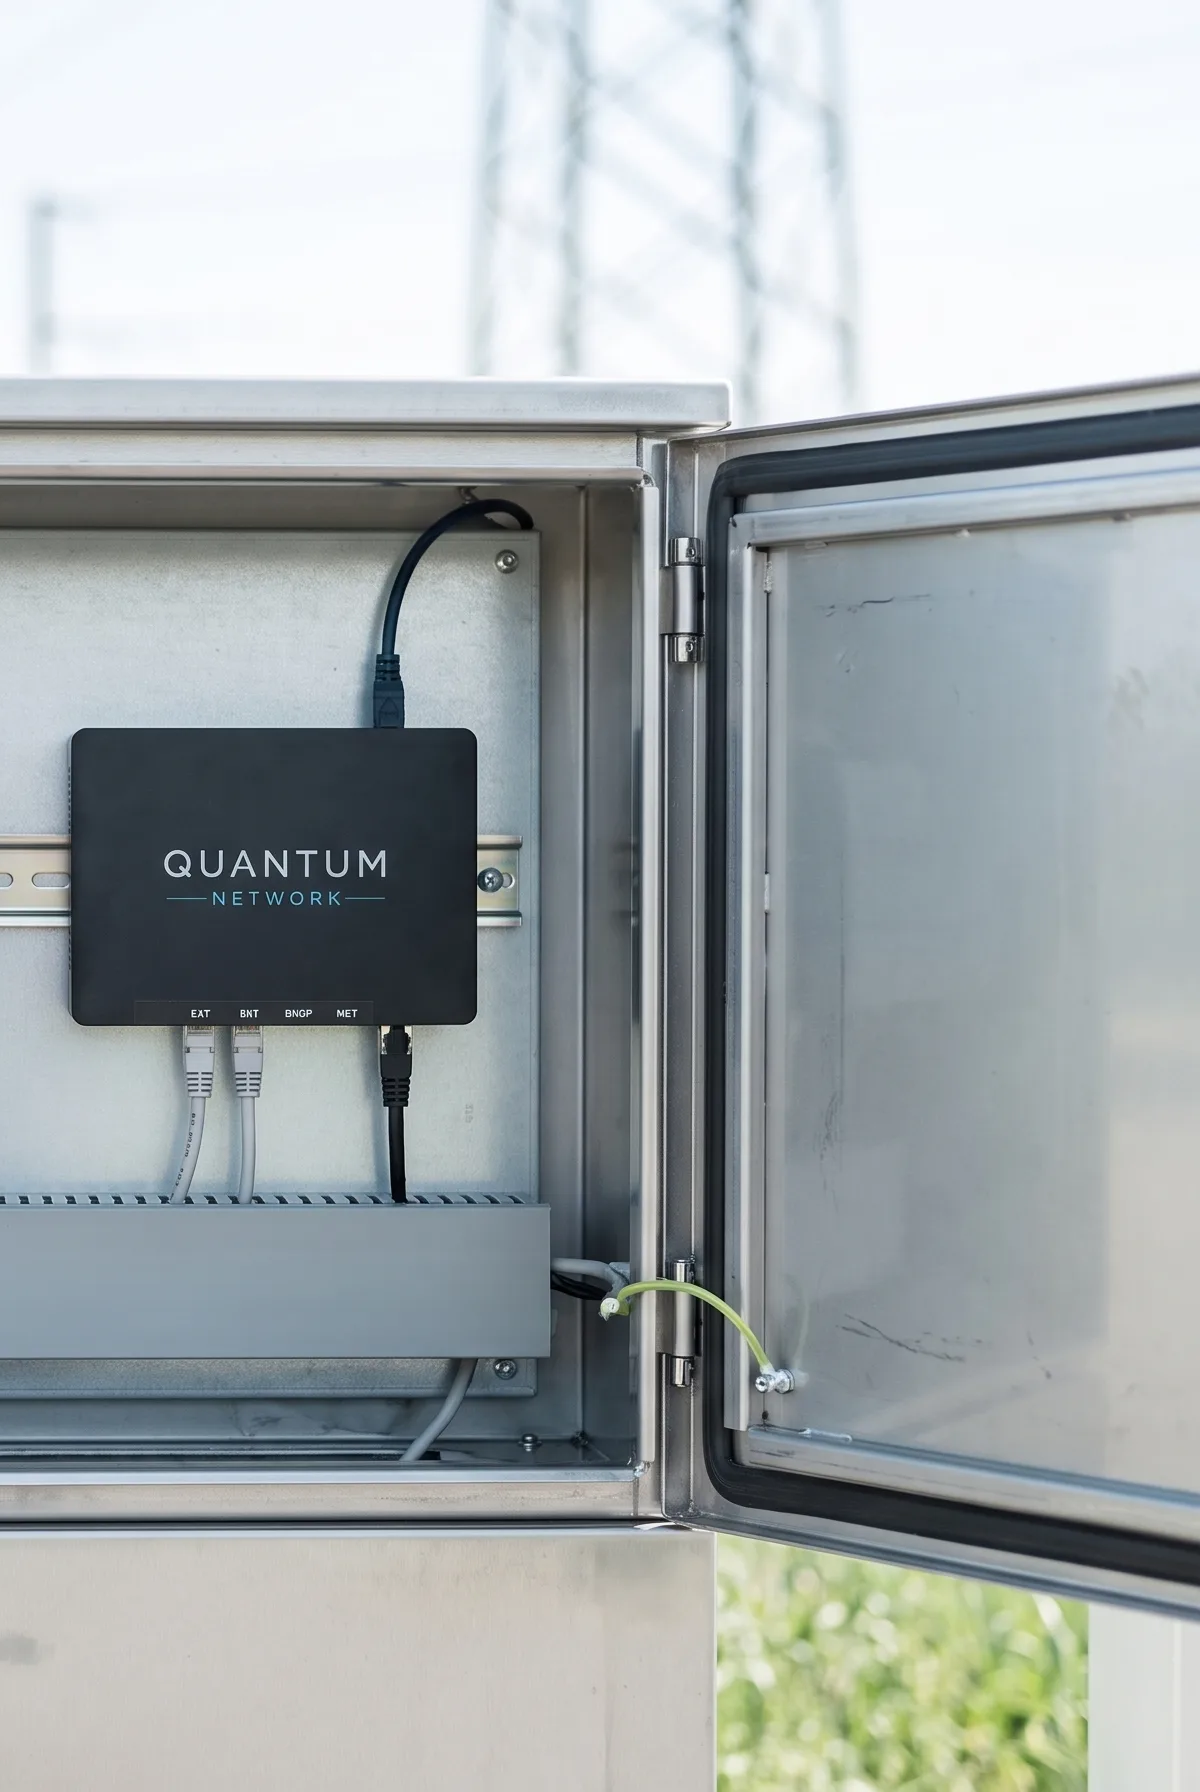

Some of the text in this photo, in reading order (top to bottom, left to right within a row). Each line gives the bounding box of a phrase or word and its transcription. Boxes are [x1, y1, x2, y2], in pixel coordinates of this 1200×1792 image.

[163, 849, 386, 878] QUANTUM
[212, 891, 341, 906] NETWORK
[240, 1009, 260, 1018] BNT
[285, 1009, 313, 1018] BNGP
[336, 1009, 358, 1018] MET
